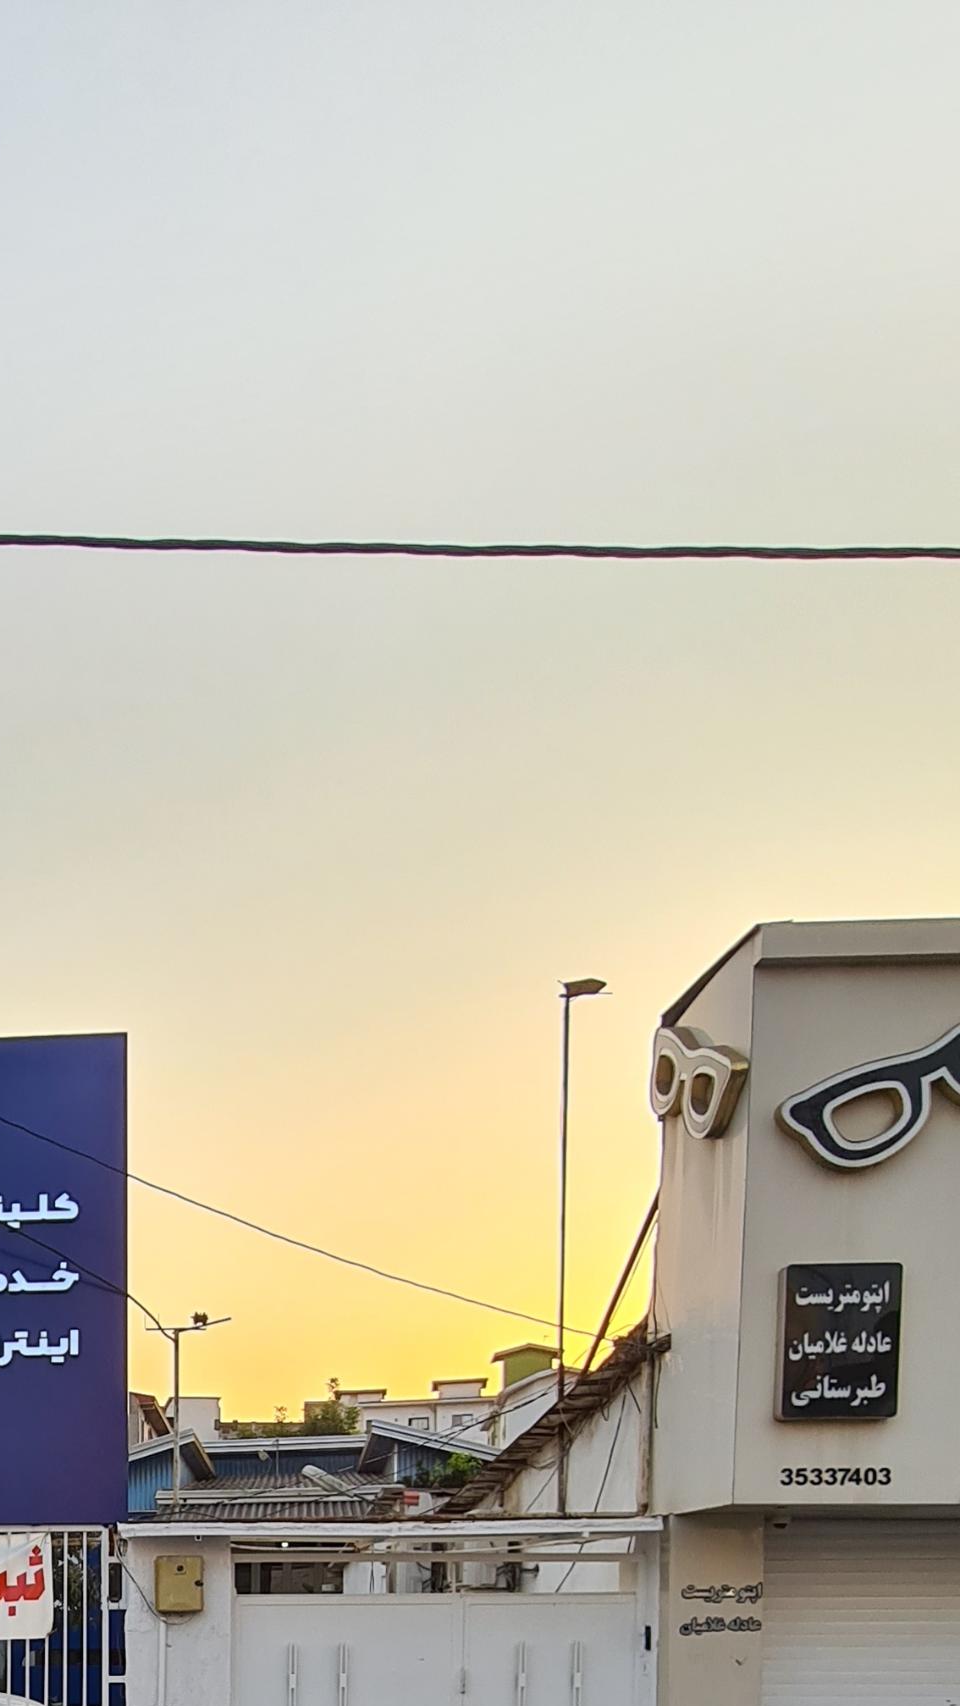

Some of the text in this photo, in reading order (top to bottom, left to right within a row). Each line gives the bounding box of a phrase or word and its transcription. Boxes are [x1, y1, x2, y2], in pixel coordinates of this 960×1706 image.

[795, 1281, 890, 1314] اپتومتریست
[789, 1331, 892, 1361] عادله غلامیان
[791, 1375, 887, 1407] طبرستانی
[780, 1467, 892, 1486] 35337403
